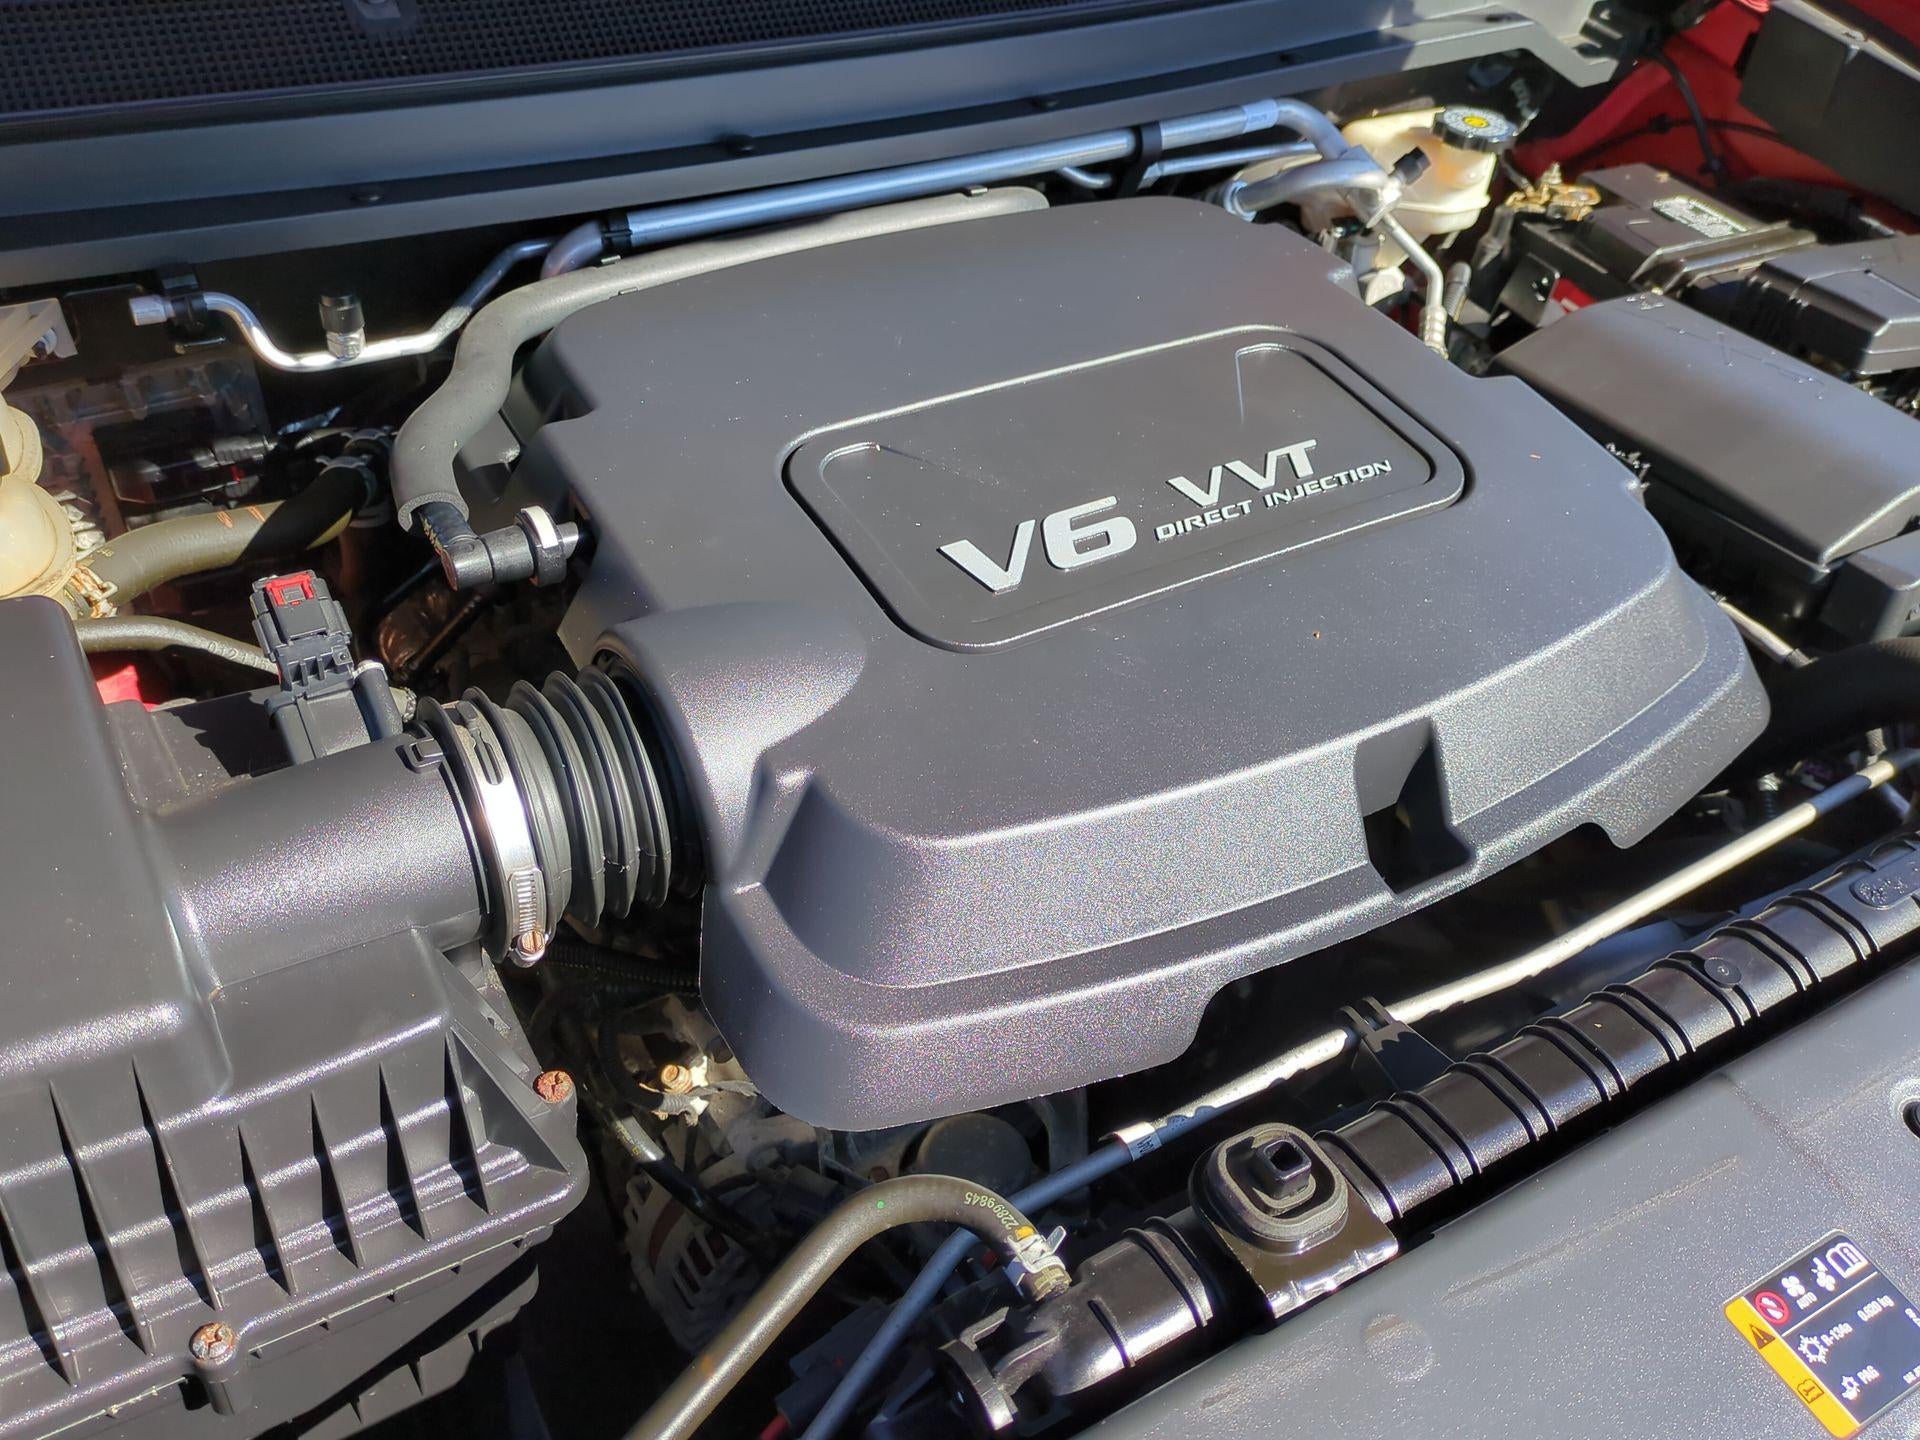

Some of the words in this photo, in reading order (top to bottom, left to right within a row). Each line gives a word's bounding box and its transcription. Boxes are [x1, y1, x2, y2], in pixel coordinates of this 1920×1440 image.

[1166, 439, 1318, 506] VVT
[1155, 500, 1252, 541] DIRECT
[1264, 460, 1393, 508] INJECTION
[938, 496, 1137, 593] V6
[964, 1191, 1020, 1230] 22899845
[1796, 1292, 1817, 1309] AUTO
[1876, 1295, 1895, 1307] kg
[1857, 1365, 1880, 1384] PAG
